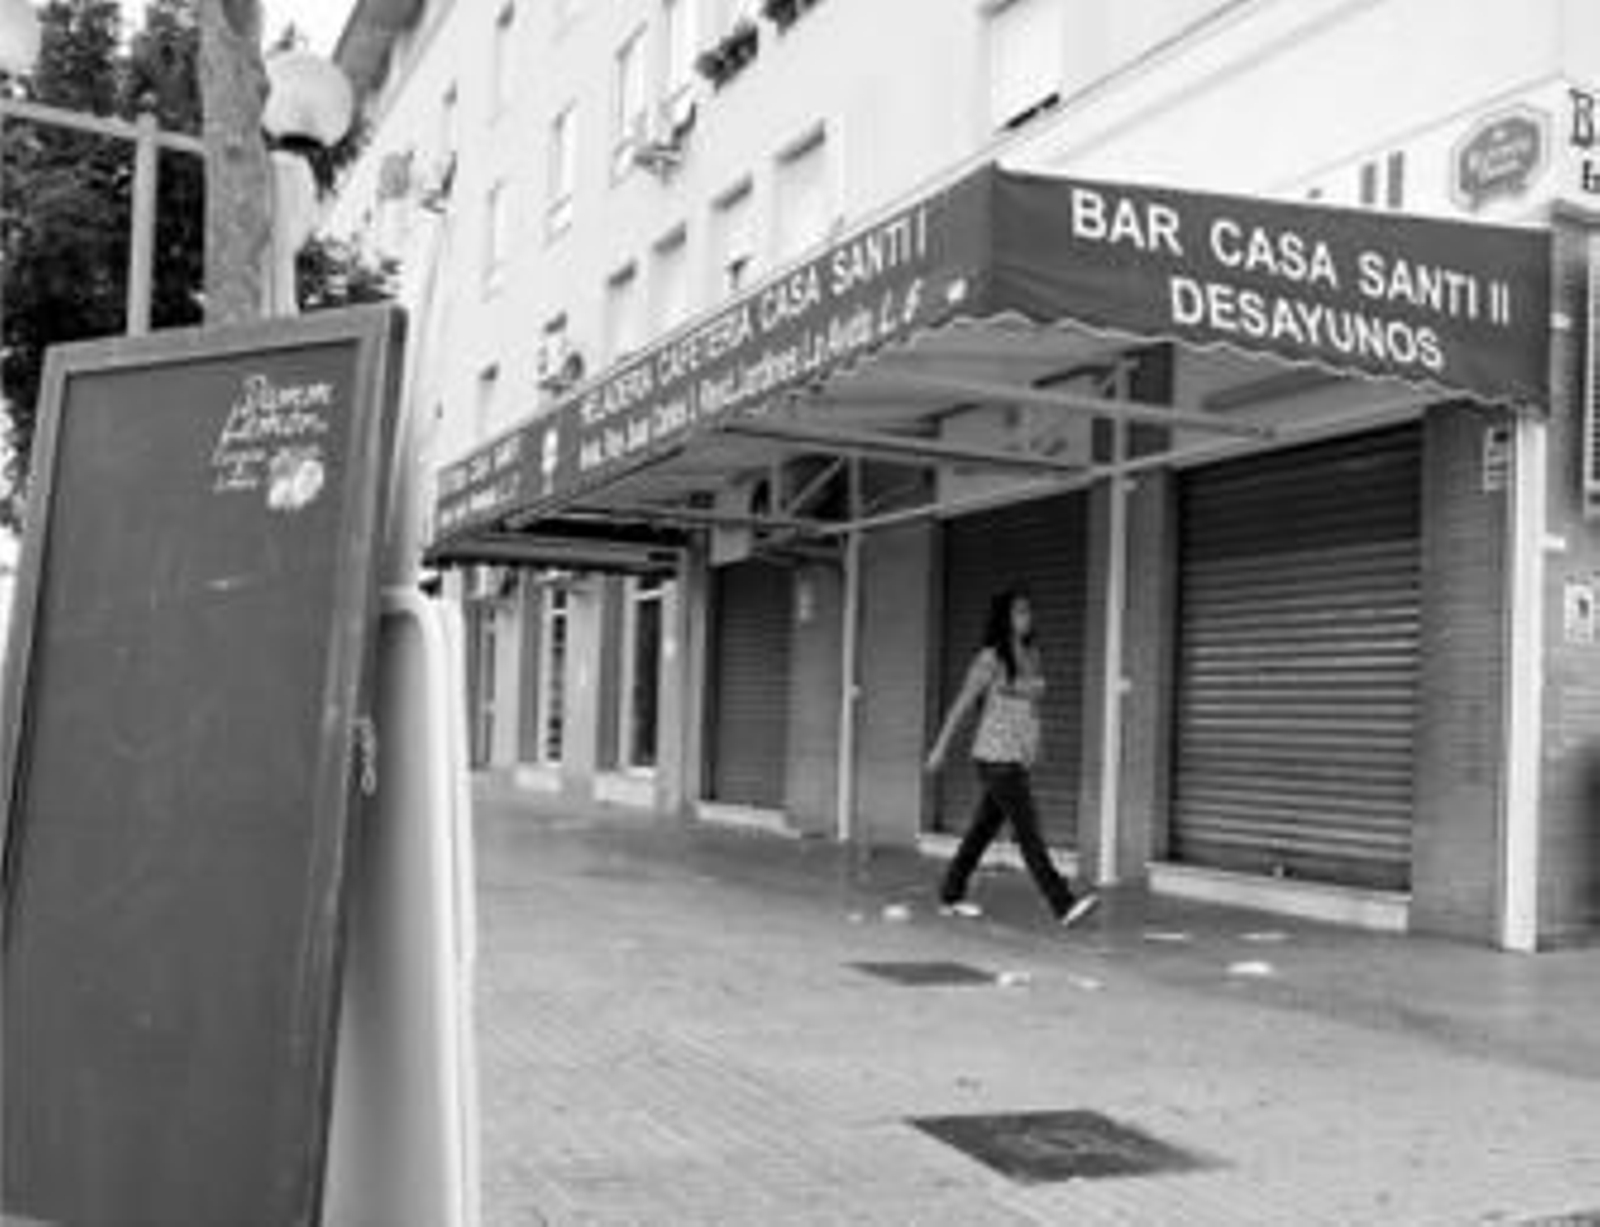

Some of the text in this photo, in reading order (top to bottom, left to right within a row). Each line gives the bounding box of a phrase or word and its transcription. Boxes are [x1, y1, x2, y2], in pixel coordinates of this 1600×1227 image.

[760, 265, 821, 333] CASA
[832, 216, 911, 297] SANTI
[1071, 187, 1509, 326] BAR CASA SANTI II
[1169, 276, 1445, 372] DESAYUNOS
